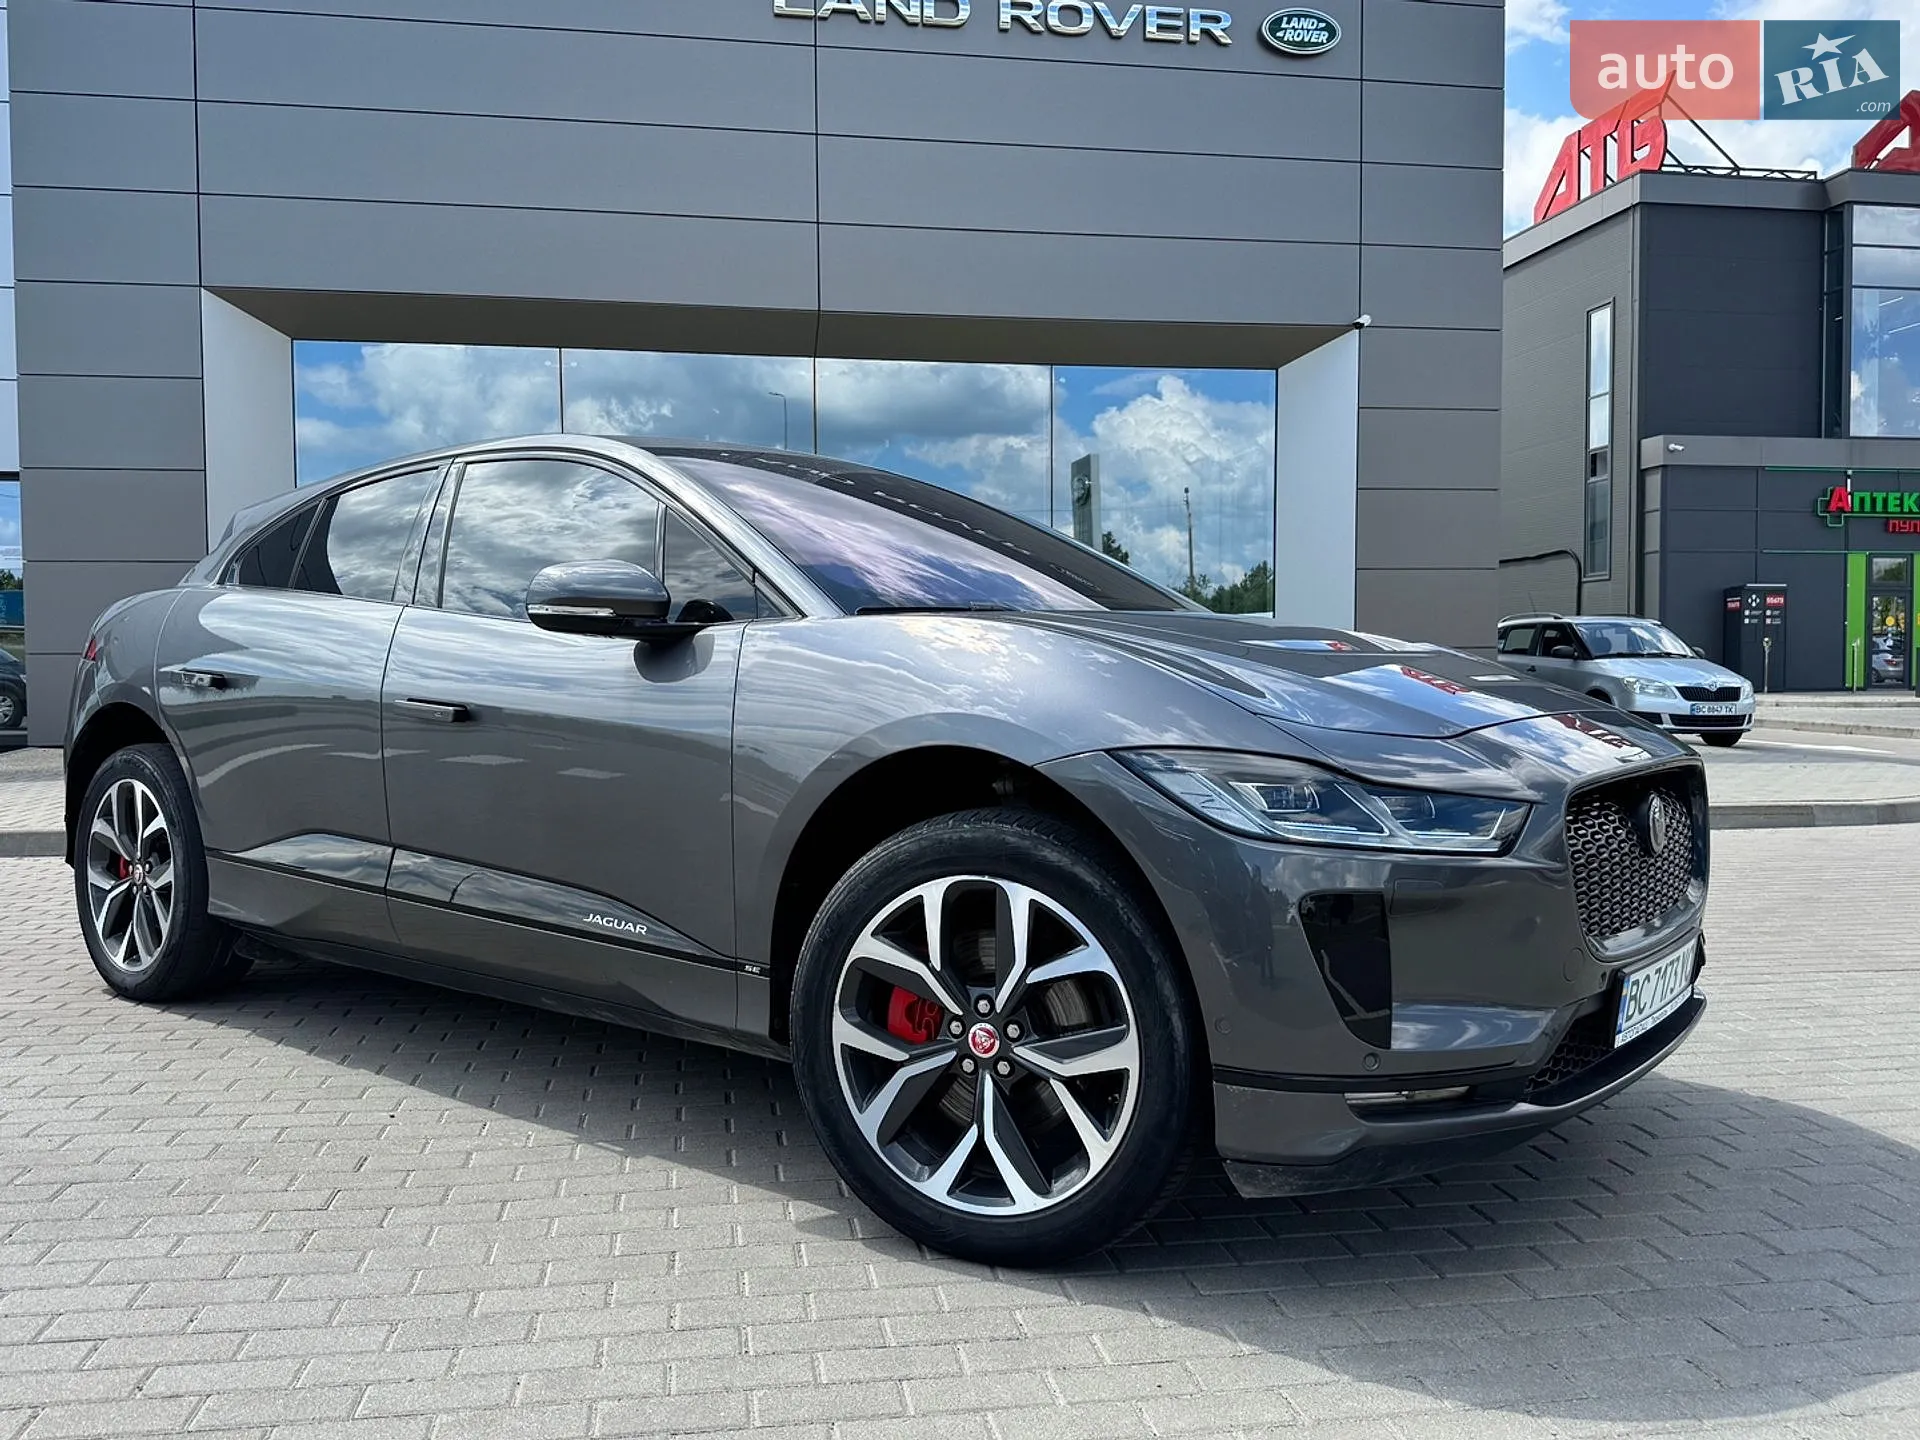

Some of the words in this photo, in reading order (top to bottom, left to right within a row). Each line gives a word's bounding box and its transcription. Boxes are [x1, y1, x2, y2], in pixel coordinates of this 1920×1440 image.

[999, 0, 1233, 45] ROVER
[1280, 16, 1318, 30] LAND
[1283, 28, 1329, 43] ROVER
[583, 913, 647, 935] JAGUAR
[744, 965, 761, 974] SE
[1624, 973, 1651, 1022] BC
[1649, 954, 1681, 1009] 7173
